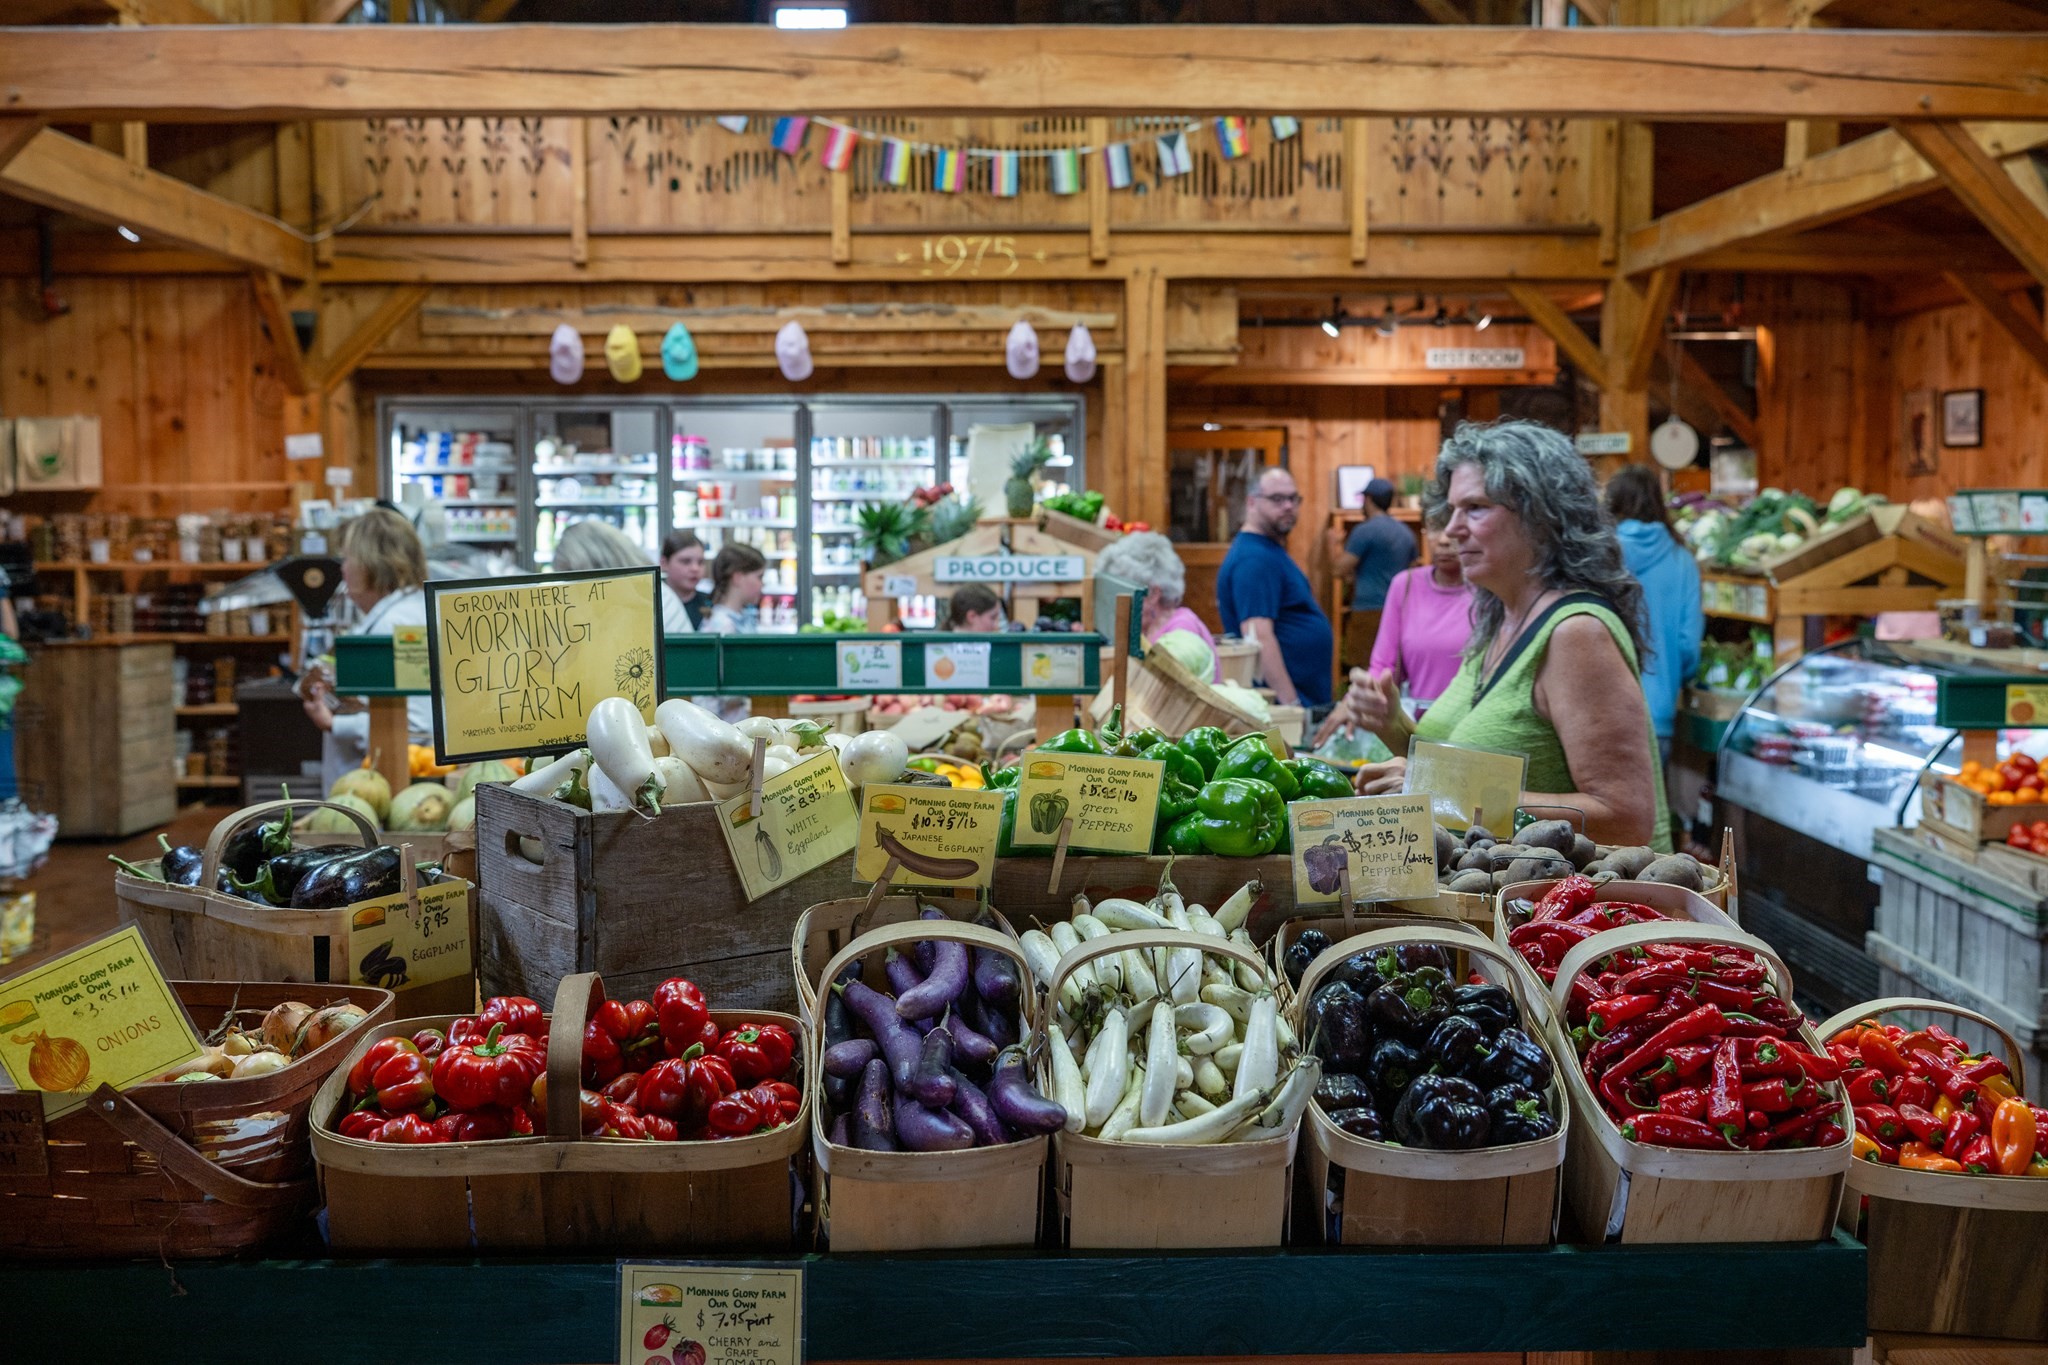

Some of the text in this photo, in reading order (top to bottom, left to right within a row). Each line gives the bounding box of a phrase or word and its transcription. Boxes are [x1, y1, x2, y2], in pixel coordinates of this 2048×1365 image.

[921, 234, 1019, 277] 1975
[949, 560, 1069, 577] PRODUCE
[453, 581, 612, 613] GROWN HERE AT
[445, 606, 591, 655] MORNING
[455, 645, 571, 694] GLORY
[498, 681, 583, 724] FARM
[498, 723, 537, 735] VINEYARD
[1068, 764, 1154, 779] MORNING GLORY FARM
[761, 765, 832, 804] MORNING GLORY FARM
[1086, 775, 1128, 785] OUR OWN
[780, 783, 816, 804] OUR OWN
[909, 797, 995, 811] MORNING GLORY FARM
[1078, 803, 1119, 817] green
[927, 807, 969, 818] OUR OWN
[1337, 805, 1424, 818] MORNING GLORY FARM
[785, 813, 820, 836] WHITE
[1078, 819, 1134, 833] PEPPERS
[1356, 816, 1399, 827] OUR OWN
[787, 825, 832, 855] Eggplant
[901, 832, 943, 843] JAPANESE
[937, 844, 985, 854] EGGPLANT
[1361, 865, 1413, 877] PEPPERS
[423, 894, 445, 906] GLORY
[445, 890, 465, 900] FARM
[425, 904, 443, 913] OWN
[412, 939, 466, 961] EGGPLANT
[34, 956, 135, 1004] MORNING GLORY FARM
[61, 979, 112, 1006] OUR OWN
[96, 1015, 162, 1052] ONIONS
[686, 1286, 787, 1299] MORNING GLORY FARM
[708, 1298, 757, 1309] OUR OWN
[708, 1337, 781, 1347] CHERRY and
[725, 1347, 759, 1357] GRAPE
